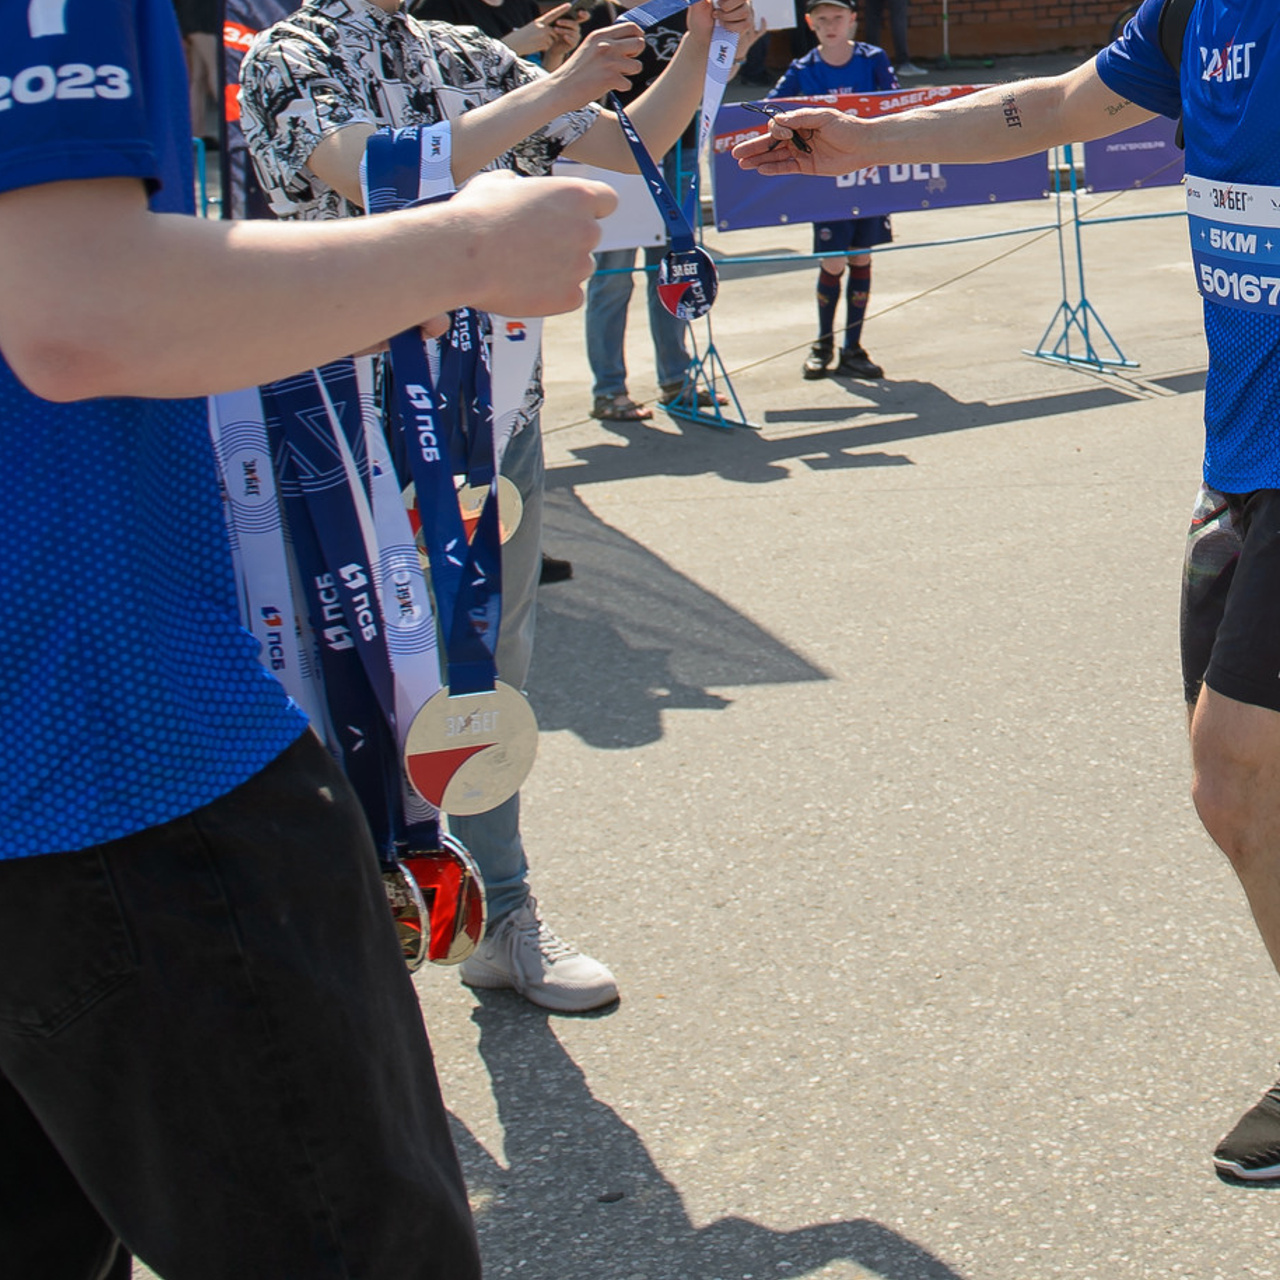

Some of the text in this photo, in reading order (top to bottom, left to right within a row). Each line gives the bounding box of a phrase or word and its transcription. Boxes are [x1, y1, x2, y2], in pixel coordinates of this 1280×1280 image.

[879, 86, 952, 111] ЗАБЕГ.РФ
[1209, 227, 1257, 255] 5КМ
[459, 321, 472, 352] ПСБ
[415, 414, 441, 462] ПСБ
[315, 572, 344, 621] ПСБ
[352, 592, 378, 641] ПСБ
[267, 631, 286, 671] ПСБ
